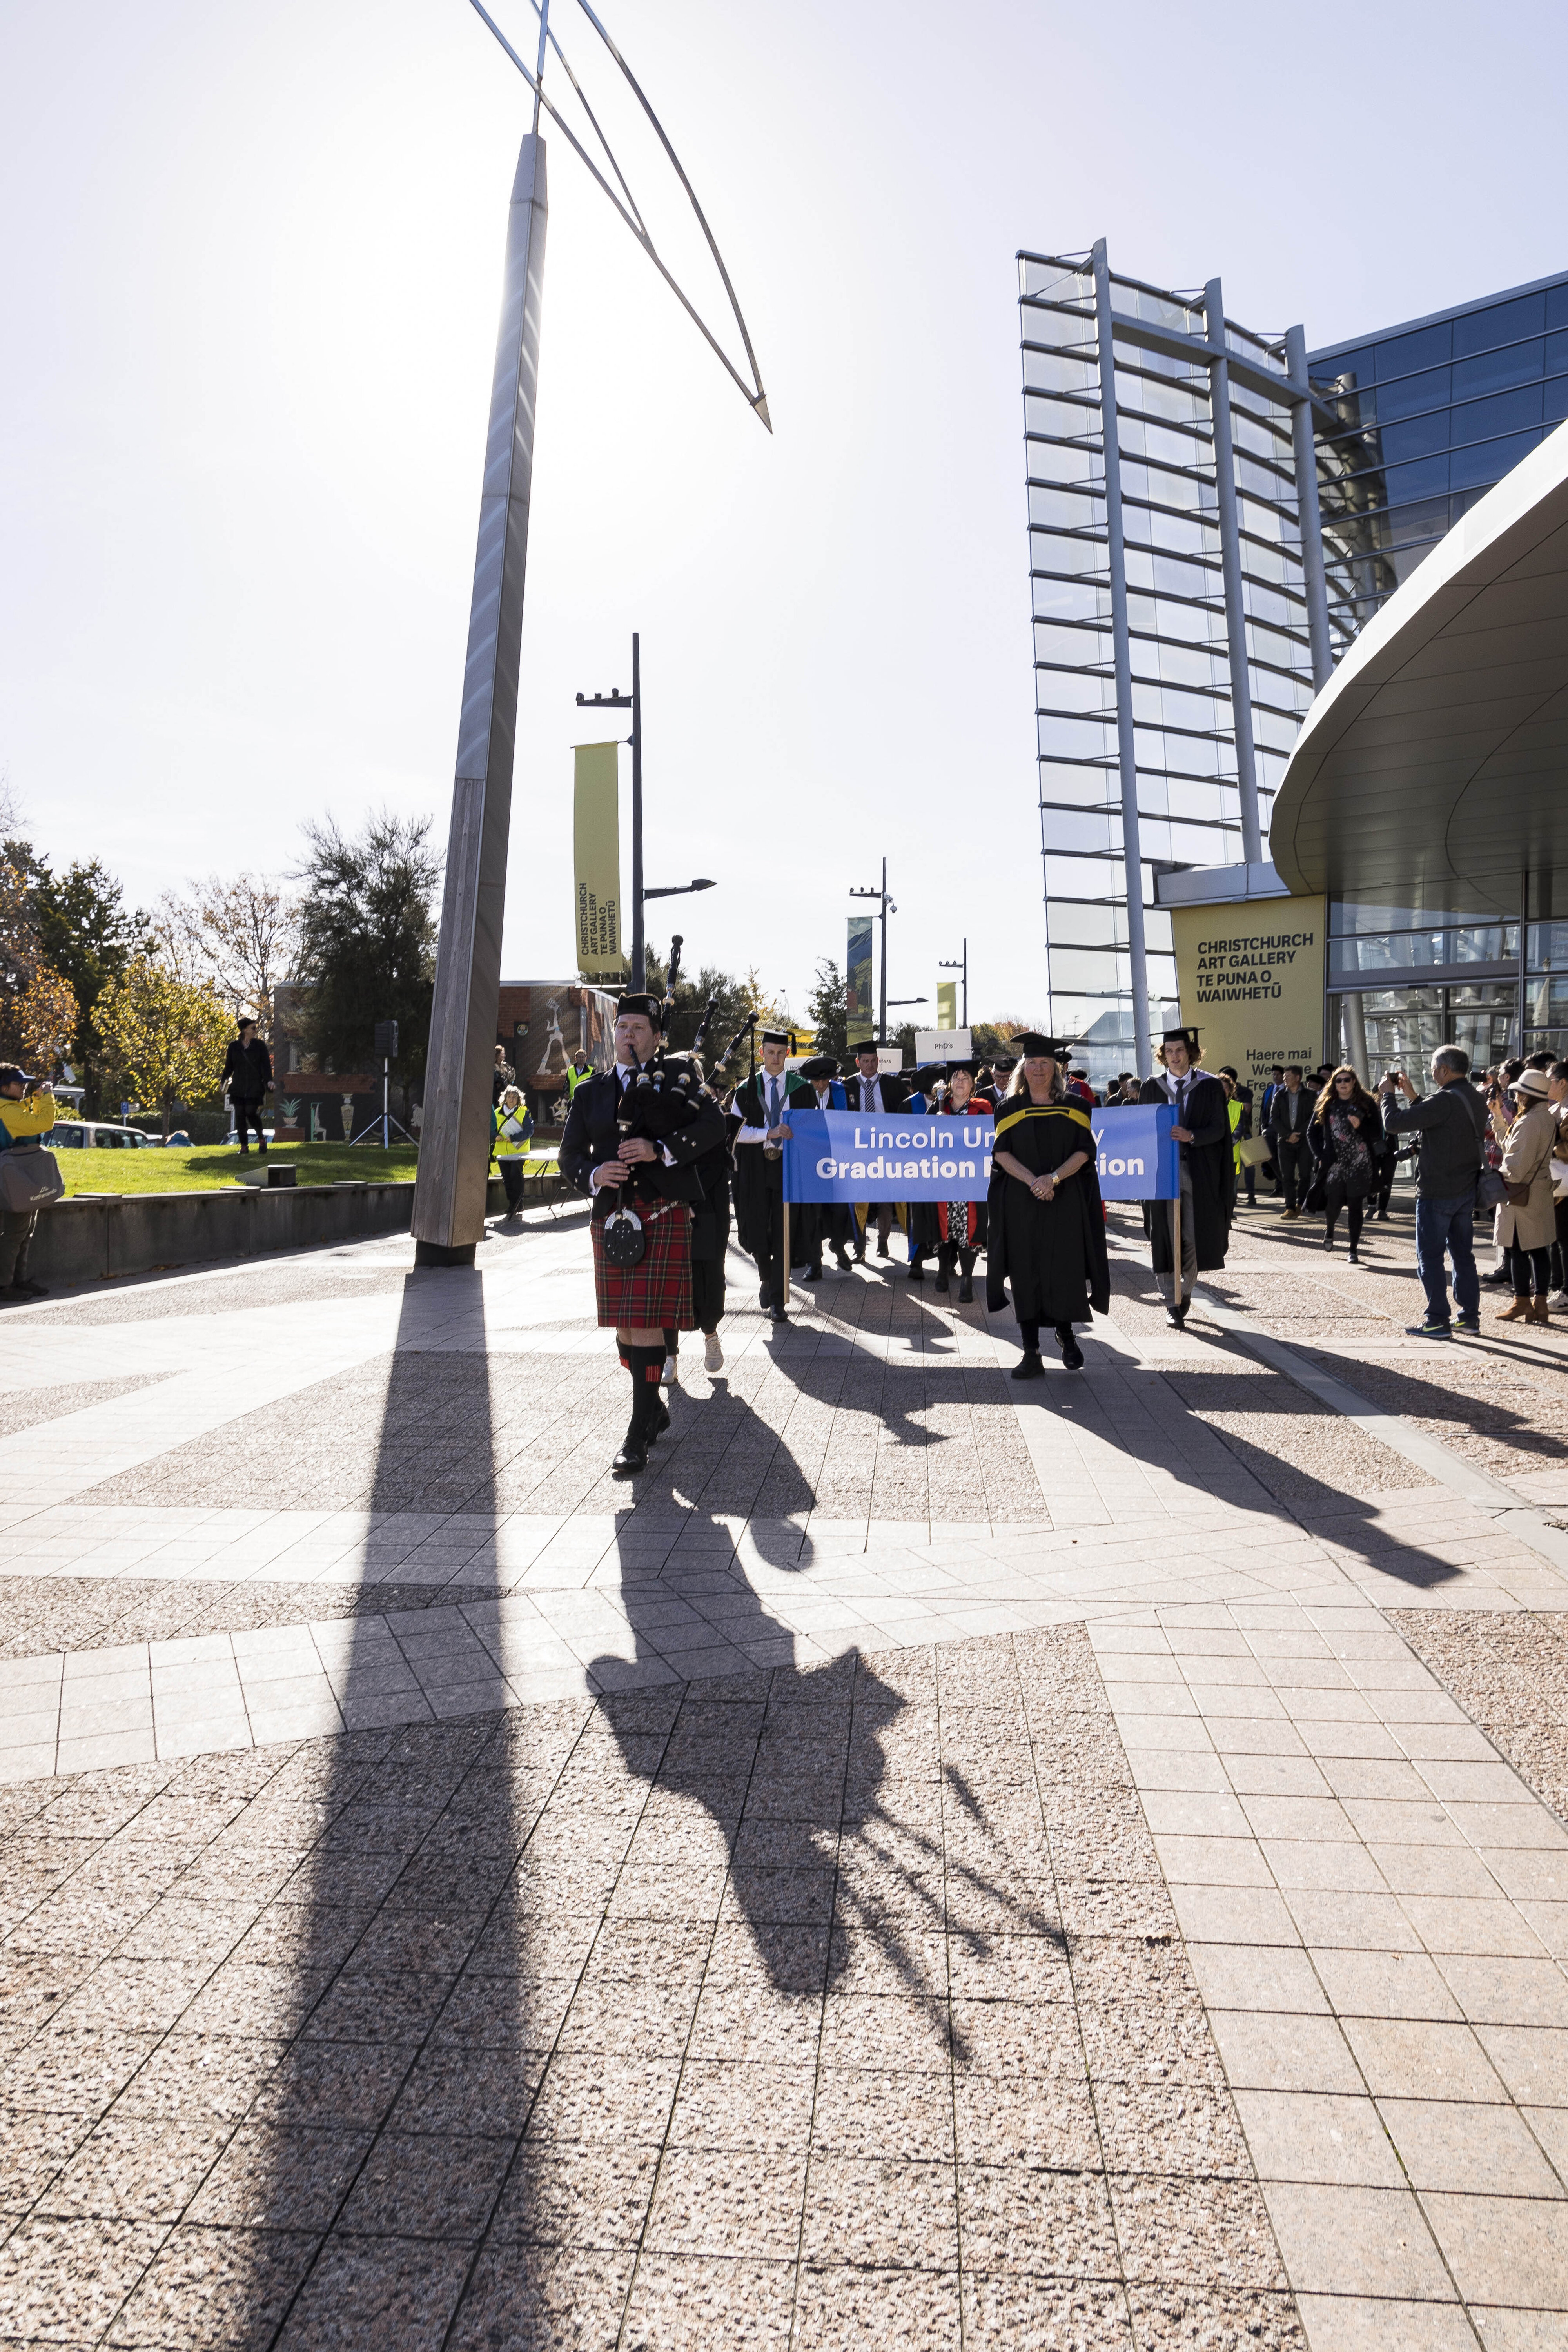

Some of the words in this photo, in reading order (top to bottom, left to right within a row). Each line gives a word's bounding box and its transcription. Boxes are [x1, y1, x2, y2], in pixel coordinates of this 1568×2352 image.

[579, 883, 589, 955] CHRISTCHURCH
[589, 893, 597, 935] GALLERY
[606, 900, 617, 955] WAIWHETŪ
[601, 944, 608, 955] TE
[1198, 933, 1314, 955] CHRISTCHURCH
[1197, 956, 1226, 970] ART
[1229, 950, 1296, 967] GALLERY
[1197, 974, 1214, 987] TE
[1217, 971, 1258, 986] PUNA
[1260, 970, 1272, 982] O
[1197, 982, 1282, 1003] WAIWHETŪ
[1247, 1049, 1285, 1061] Haere
[1288, 1047, 1312, 1059] mai
[855, 1126, 953, 1149] Lincoln
[816, 1155, 975, 1179] Graduation
